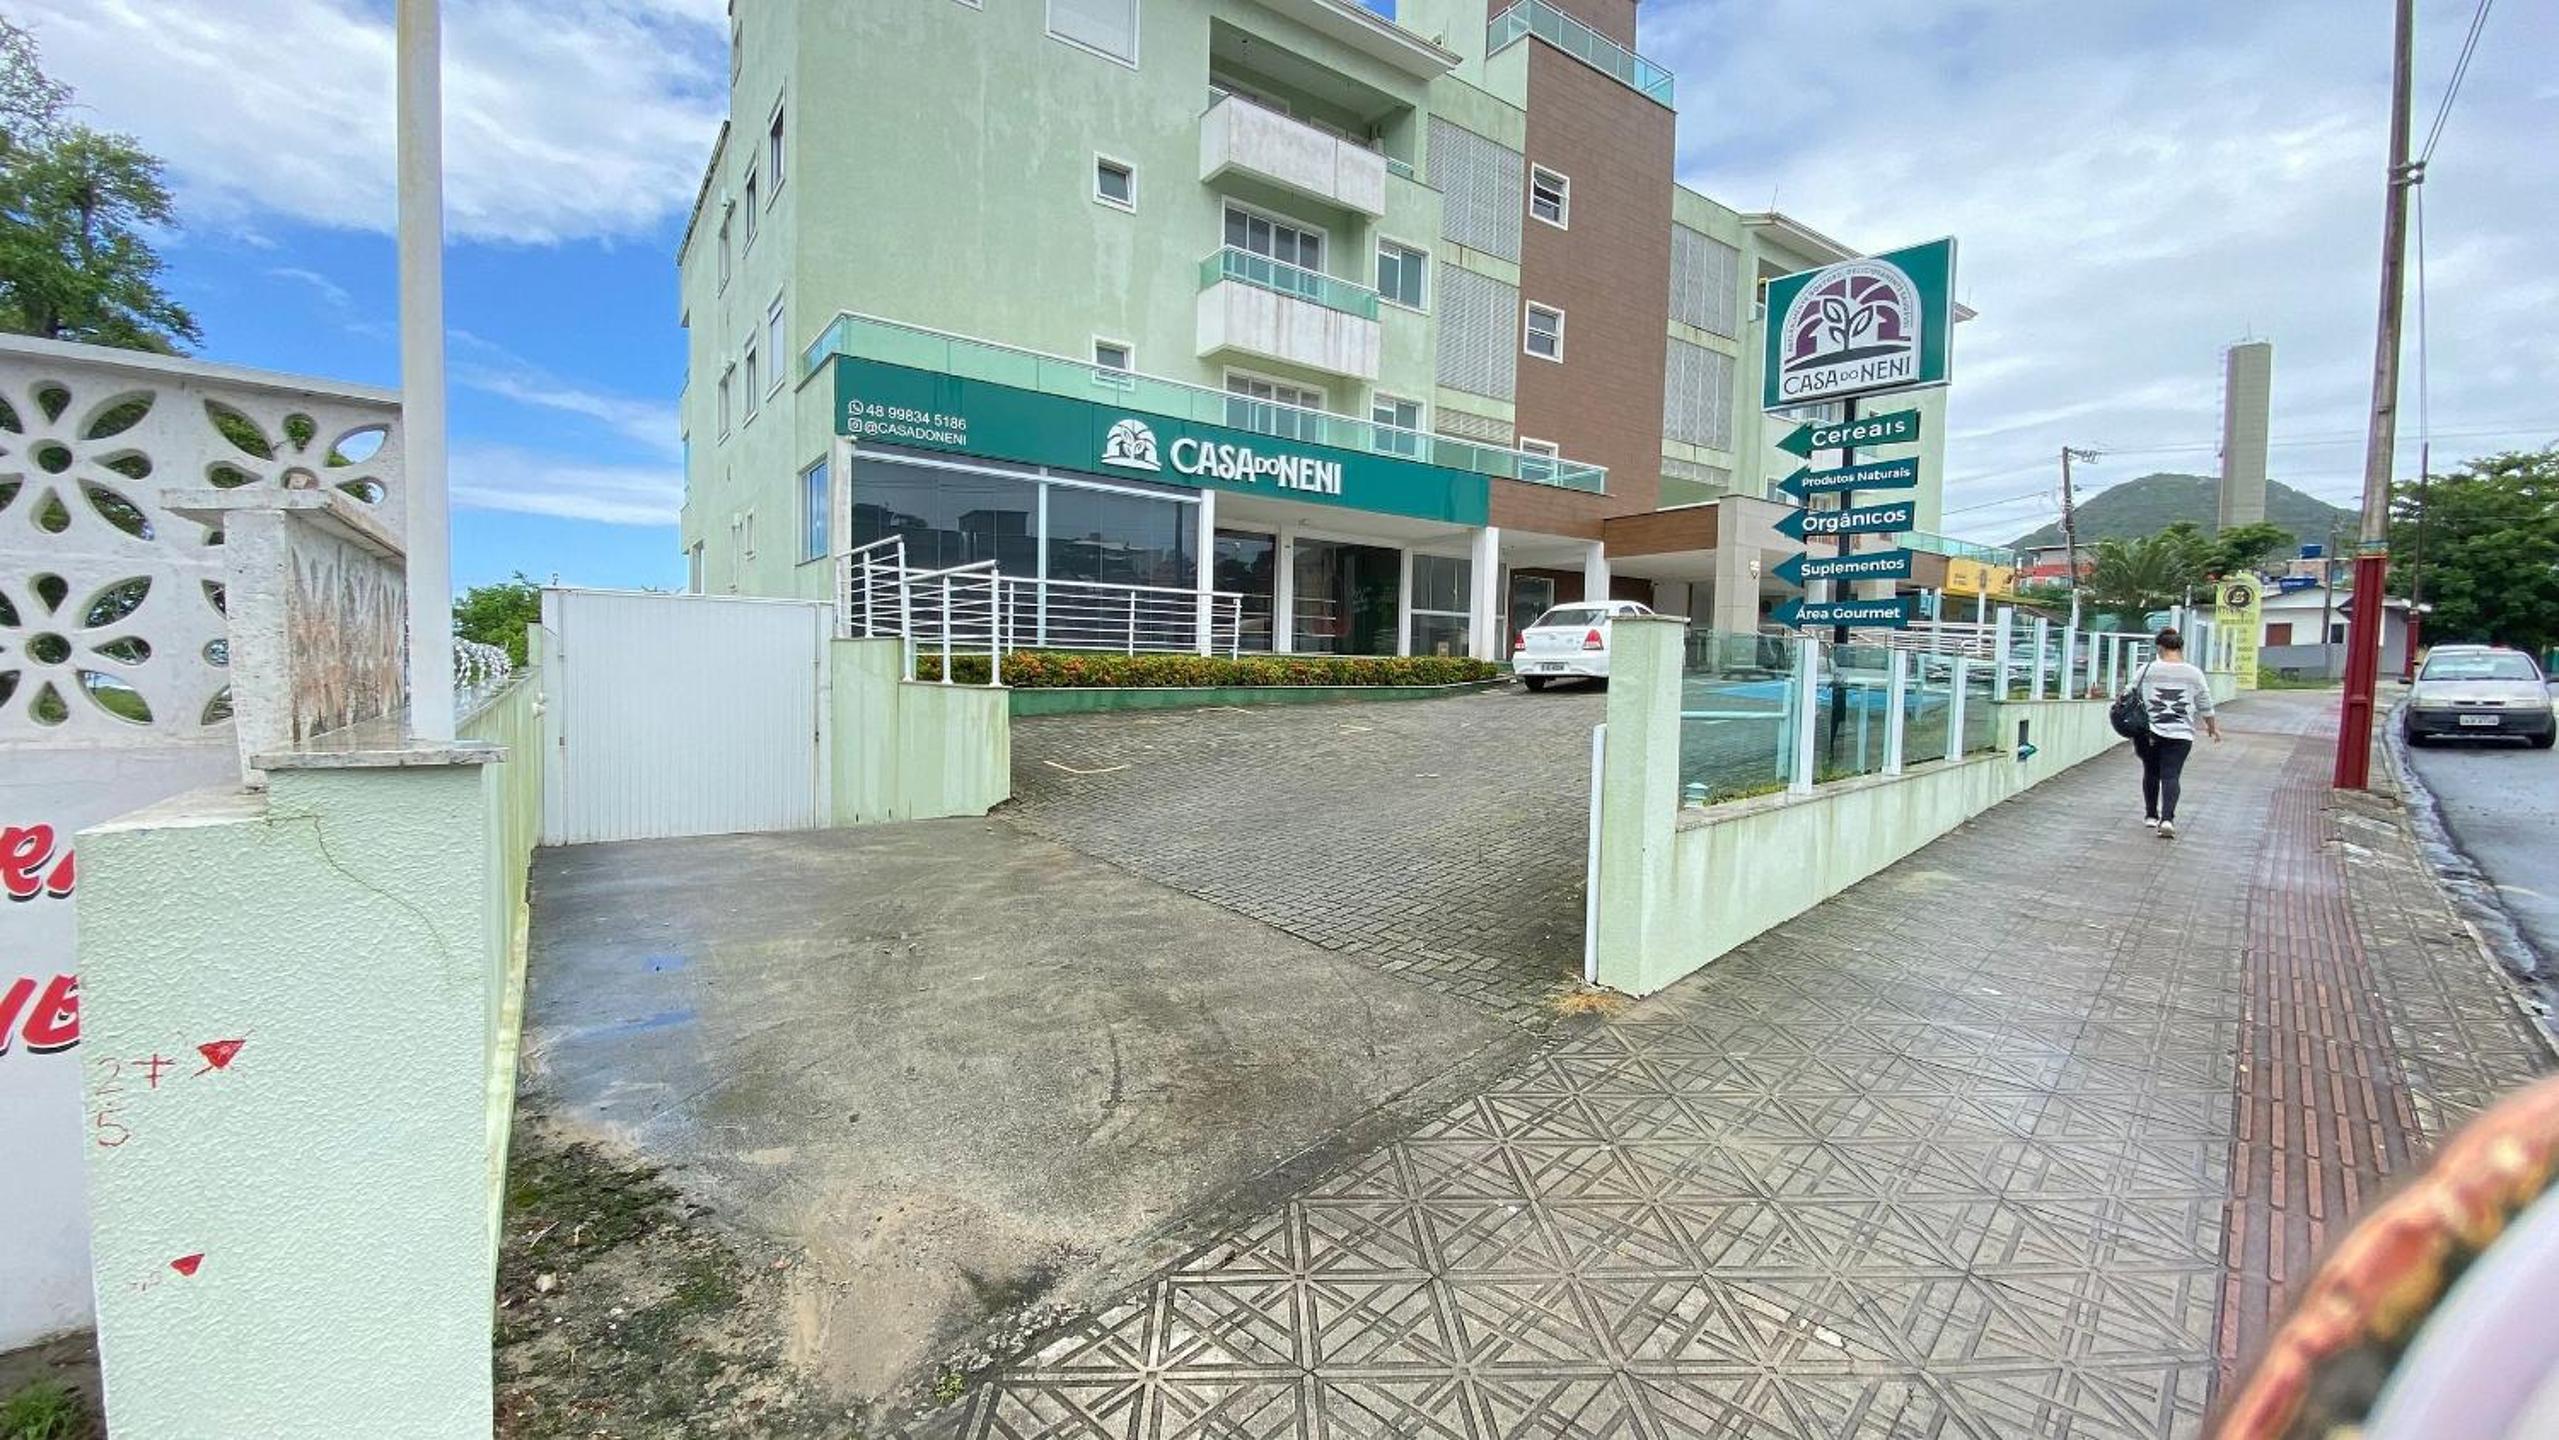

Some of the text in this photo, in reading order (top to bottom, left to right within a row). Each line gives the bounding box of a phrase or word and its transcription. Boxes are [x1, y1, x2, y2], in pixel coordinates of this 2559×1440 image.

[1784, 356, 1911, 394] CASA DO NENI
[866, 404, 967, 430] 48 99834 5186
[864, 421, 967, 446] @CASADONENI
[1811, 420, 1905, 446] Cereais
[1170, 438, 1256, 482] CASA
[1277, 455, 1342, 495] NENI
[1802, 466, 1911, 487] Produtos Naturais
[1802, 509, 1906, 533] Orgânicos
[1801, 558, 1905, 577] Suplementos
[1796, 606, 1900, 620] Área Gourmet
